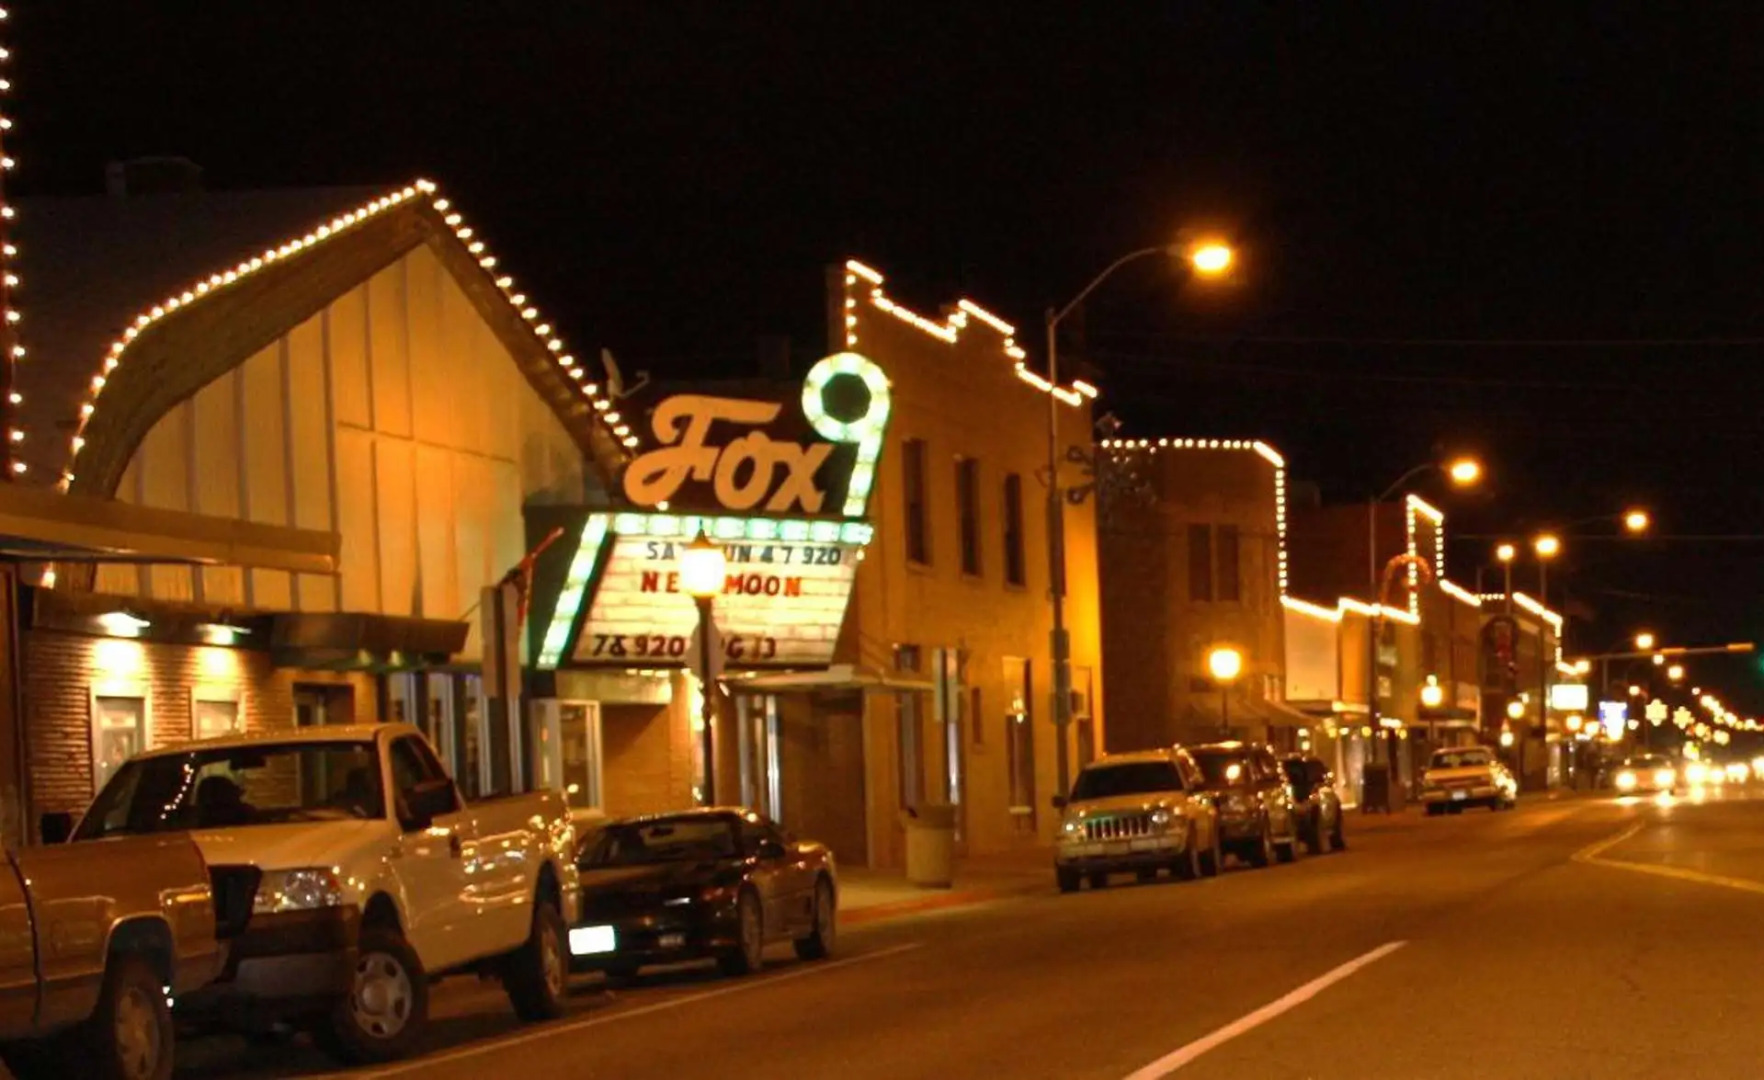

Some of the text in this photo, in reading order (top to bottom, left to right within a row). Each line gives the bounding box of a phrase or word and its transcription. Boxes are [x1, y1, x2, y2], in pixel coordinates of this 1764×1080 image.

[624, 394, 834, 513] Fox
[646, 541, 684, 561] SA
[720, 547, 751, 563] UN
[801, 547, 841, 565] 920
[640, 571, 803, 597] NE MOON
[635, 635, 686, 658] 920
[721, 637, 744, 660] G
